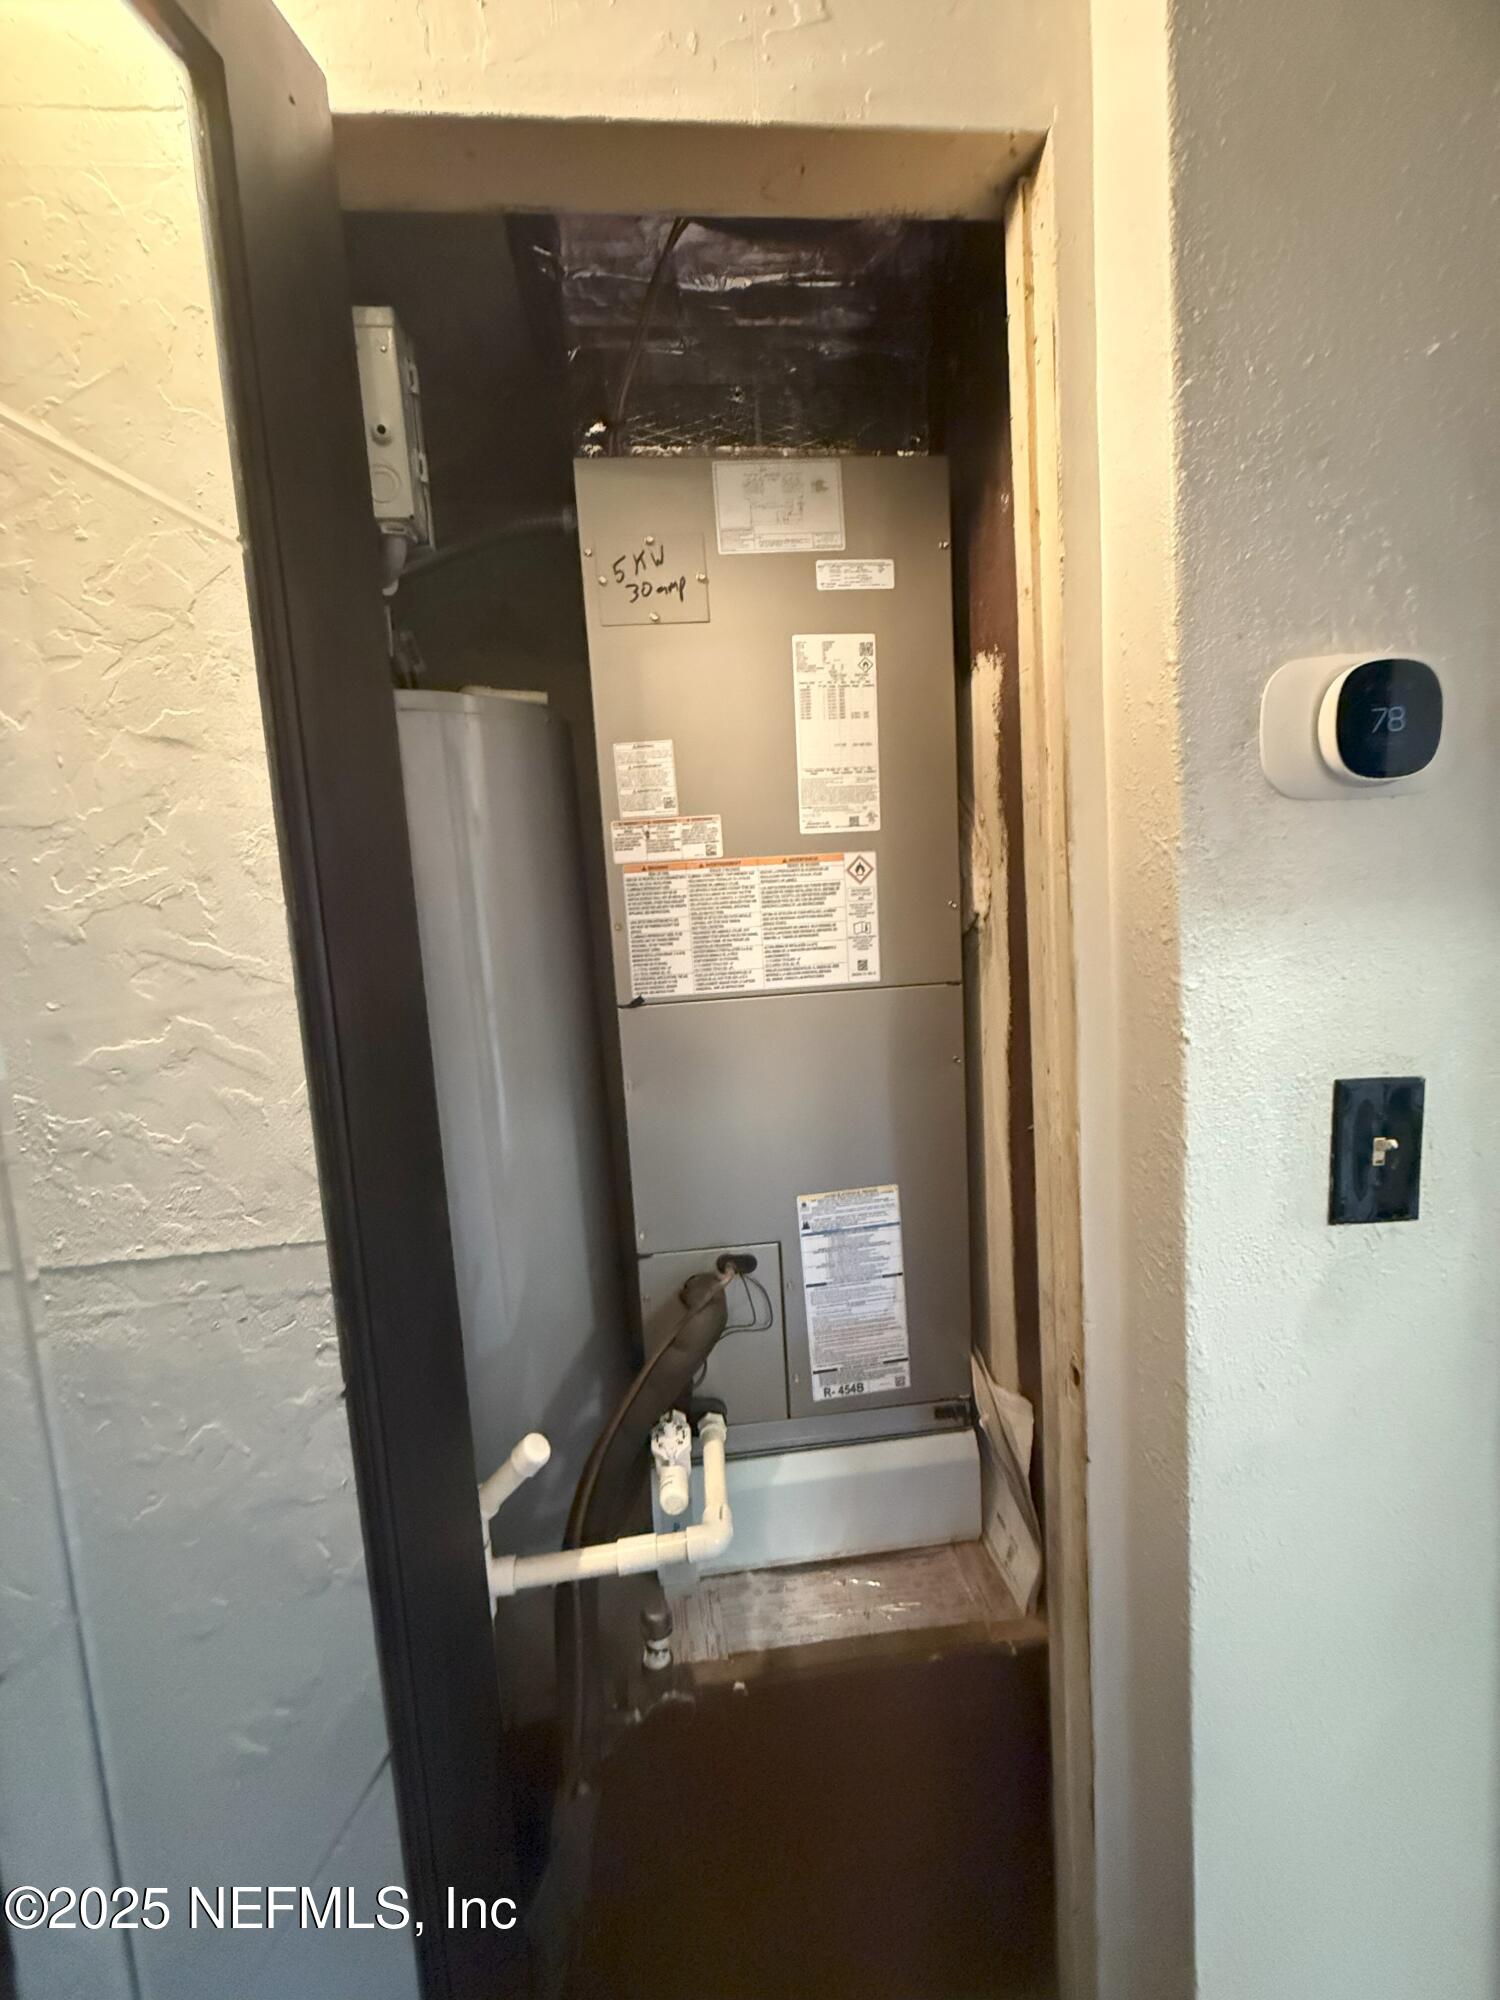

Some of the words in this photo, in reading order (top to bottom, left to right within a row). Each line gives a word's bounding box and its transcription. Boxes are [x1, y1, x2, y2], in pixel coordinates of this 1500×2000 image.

[613, 554, 626, 584] 5
[632, 544, 664, 576] KW
[625, 581, 653, 604] 30
[656, 575, 686, 603] amp
[1371, 705, 1406, 734] 78
[838, 1382, 865, 1395] 454B
